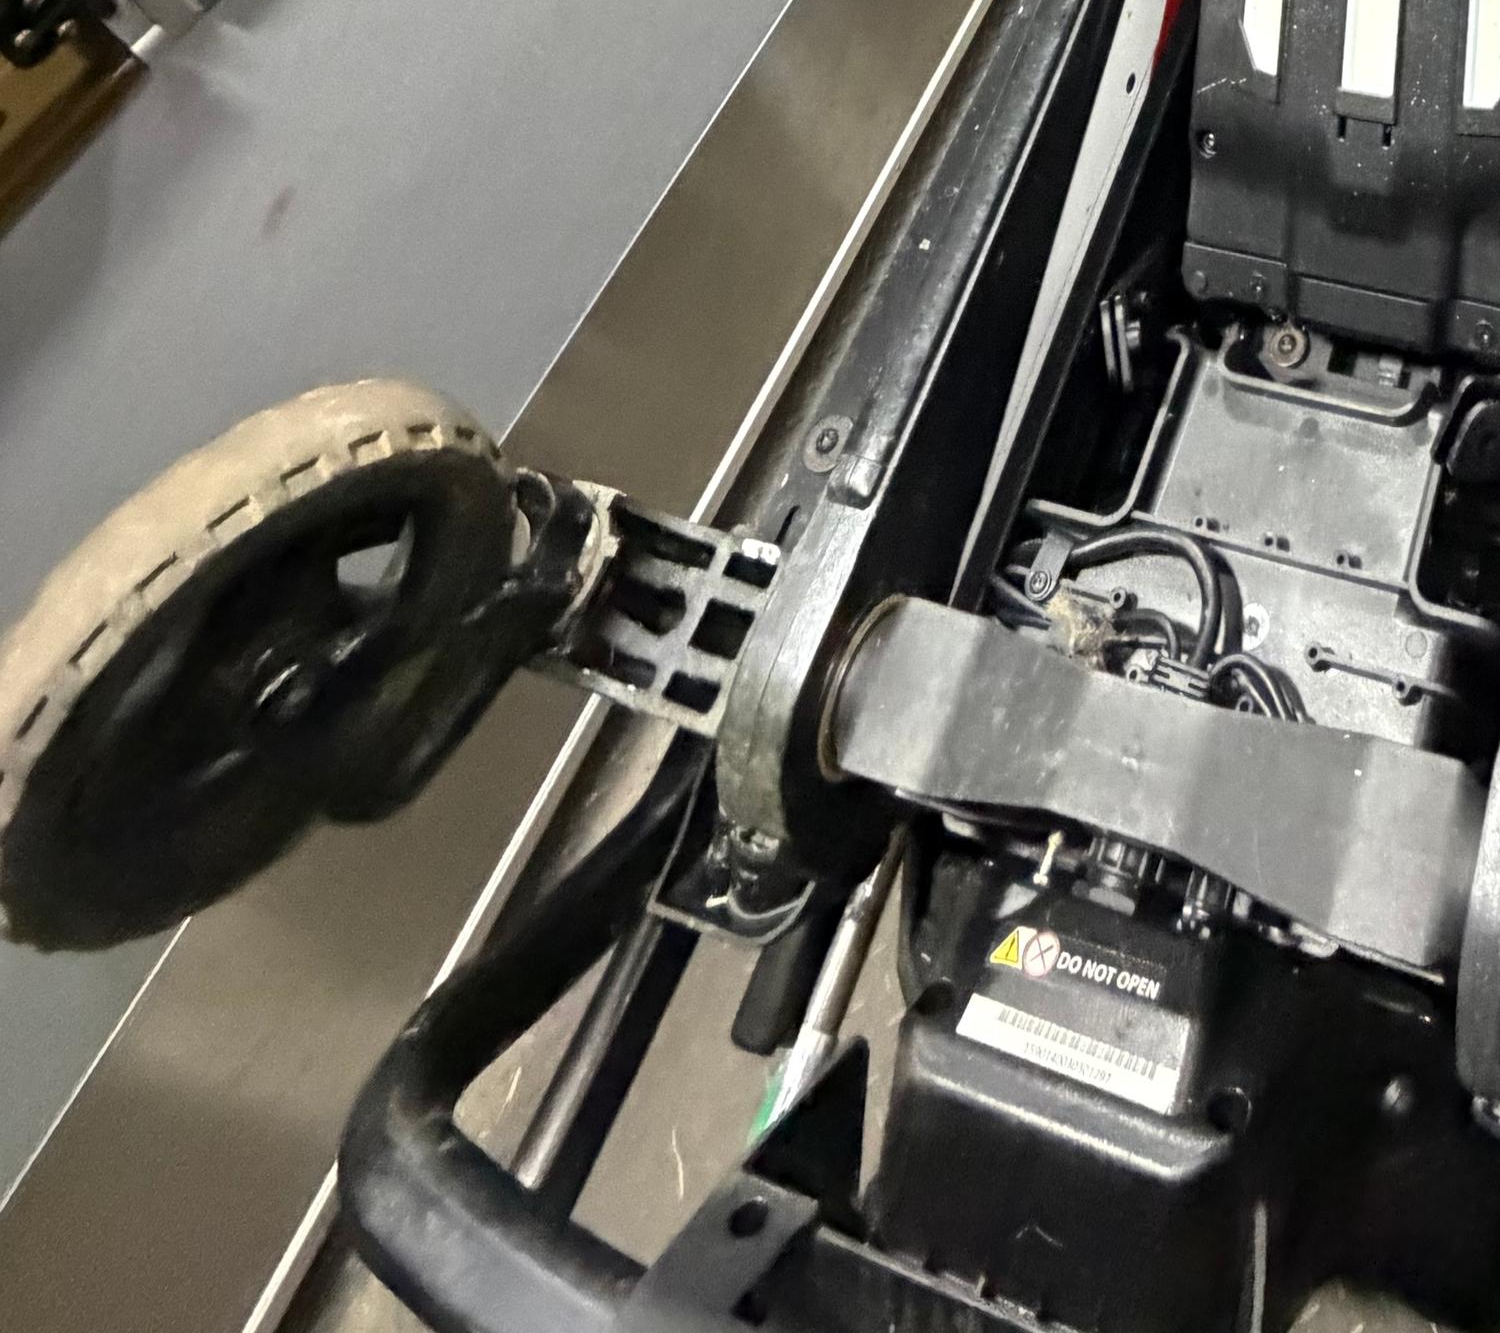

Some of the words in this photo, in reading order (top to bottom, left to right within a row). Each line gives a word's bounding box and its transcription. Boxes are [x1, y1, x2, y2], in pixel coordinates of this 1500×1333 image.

[1056, 951, 1082, 975] DO
[1082, 958, 1118, 985] NOT
[1116, 970, 1161, 1001] OPEN
